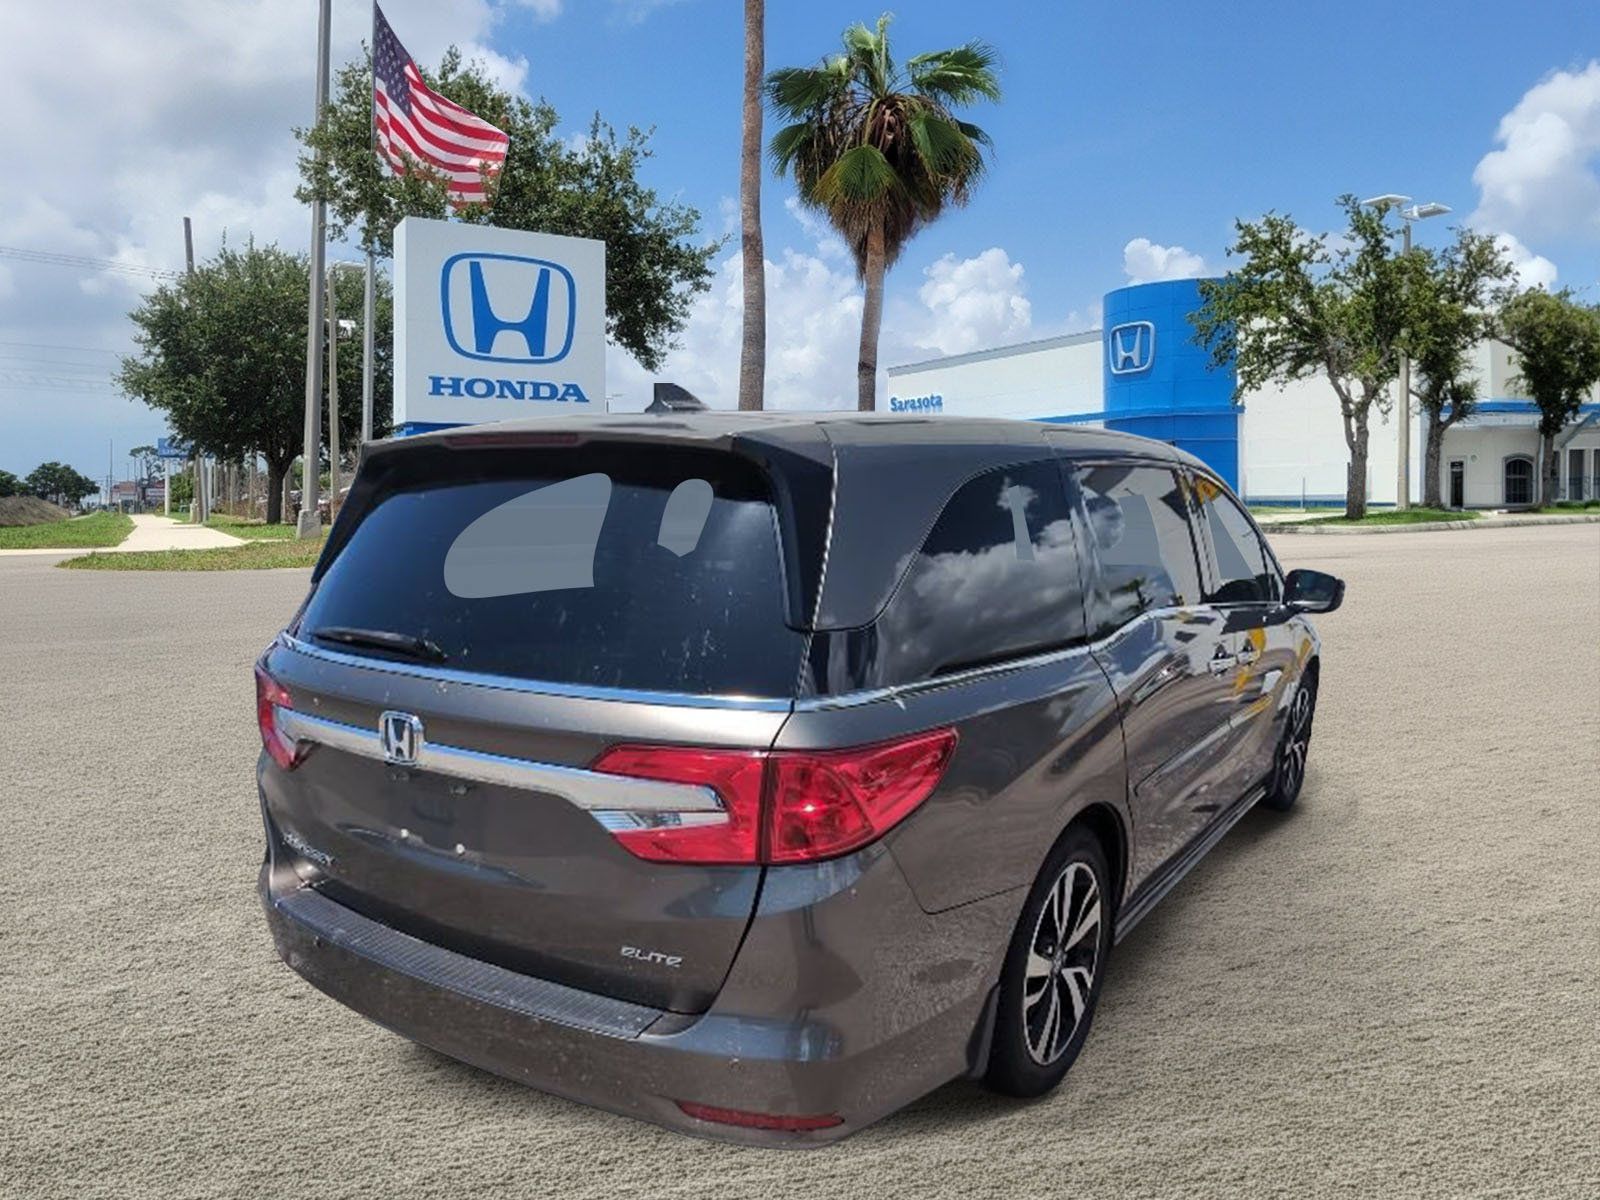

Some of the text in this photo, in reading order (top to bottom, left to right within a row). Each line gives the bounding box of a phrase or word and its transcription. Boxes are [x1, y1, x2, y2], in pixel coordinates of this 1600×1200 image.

[428, 376, 590, 403] HONDA
[890, 393, 943, 412] Sarasota
[621, 946, 683, 968] ELITE
